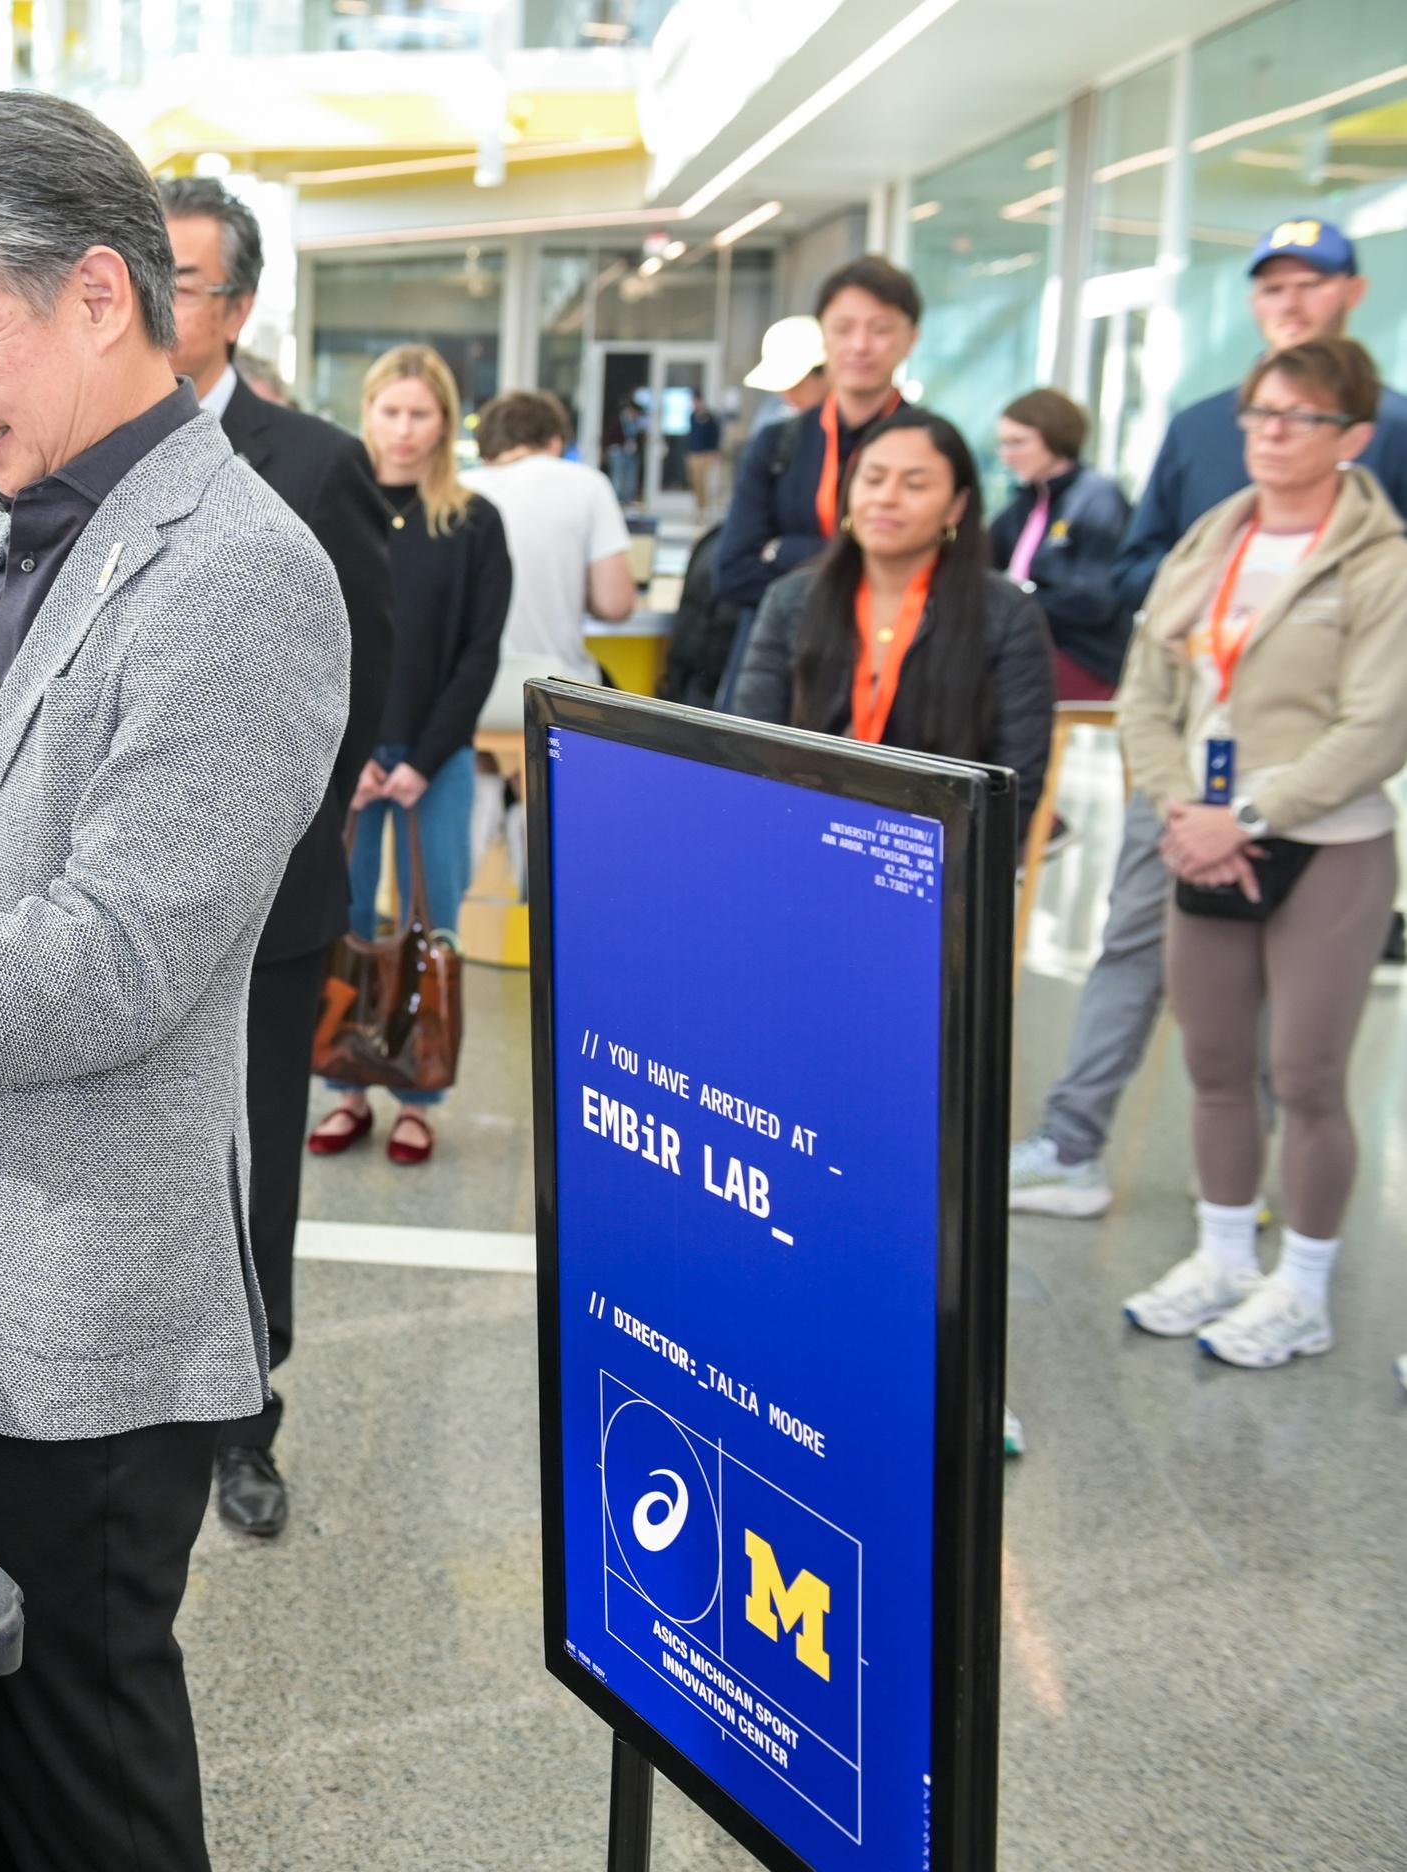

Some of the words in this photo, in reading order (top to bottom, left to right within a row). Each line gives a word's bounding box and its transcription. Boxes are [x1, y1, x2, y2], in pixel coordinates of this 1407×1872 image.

[830, 821, 877, 842] UNIVERSITY
[879, 834, 890, 846] OF
[893, 838, 934, 858] MICHIGAN
[917, 858, 934, 872] USA
[582, 1084, 681, 1176] EMBiR
[608, 1041, 639, 1075] YOU
[648, 1059, 690, 1100] HAVE
[699, 1083, 781, 1140] ARRIVED
[791, 1124, 818, 1156] AT
[769, 1403, 826, 1459] MOORE
[744, 1528, 830, 1682] M
[653, 1619, 688, 1660] ASICS
[690, 1648, 753, 1714] MICHIGAN
[755, 1702, 799, 1750] SPORT
[662, 1650, 736, 1725] INNOVATION
[738, 1714, 789, 1769] CENTER
